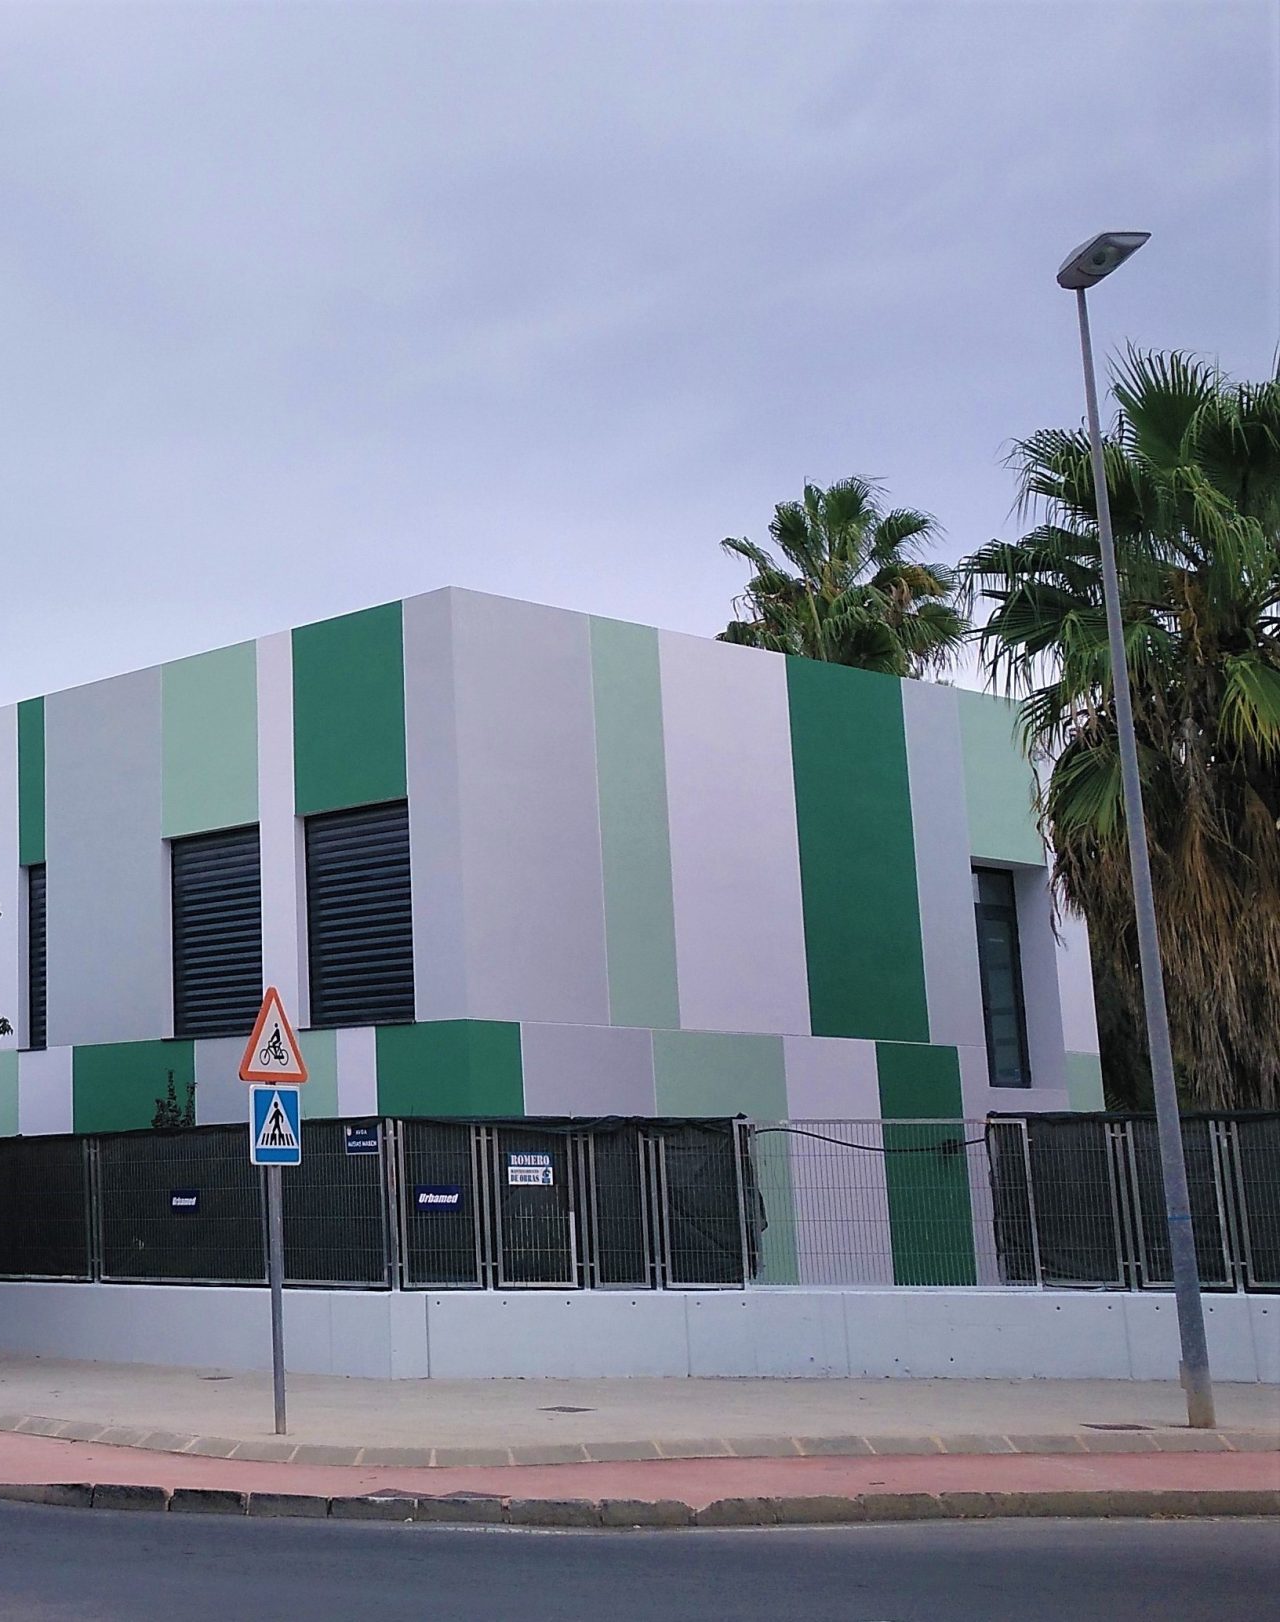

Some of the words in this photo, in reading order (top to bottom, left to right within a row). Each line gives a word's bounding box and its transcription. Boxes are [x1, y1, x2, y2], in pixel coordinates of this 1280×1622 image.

[511, 1154, 550, 1166] ROMERO
[510, 1174, 519, 1182] DE
[520, 1174, 540, 1182] OBRAS
[419, 1193, 459, 1204] Urbamed
